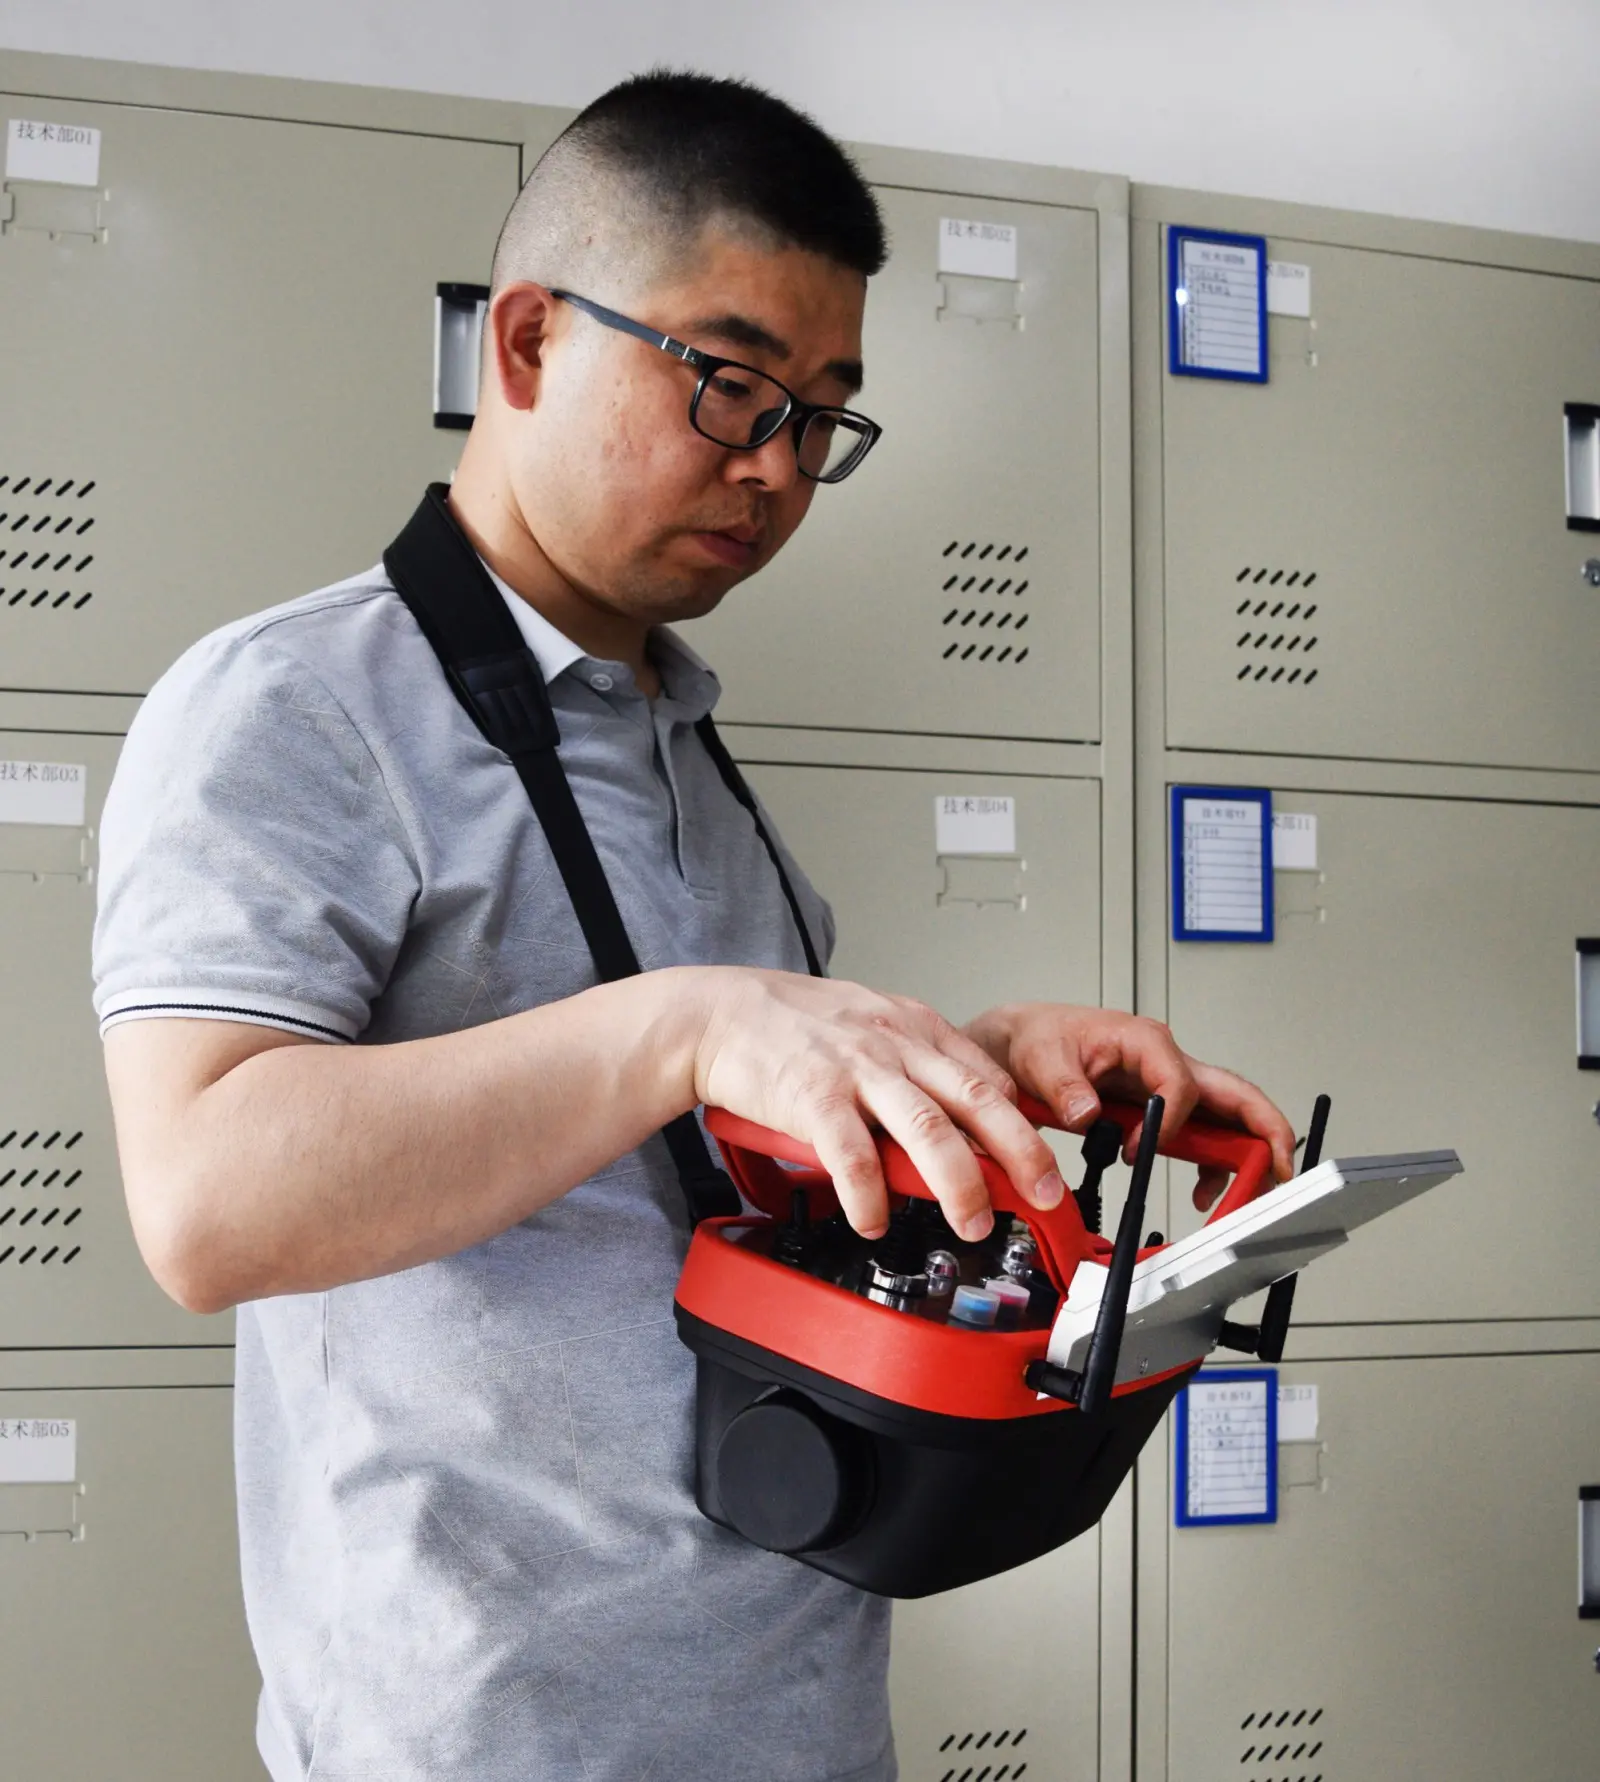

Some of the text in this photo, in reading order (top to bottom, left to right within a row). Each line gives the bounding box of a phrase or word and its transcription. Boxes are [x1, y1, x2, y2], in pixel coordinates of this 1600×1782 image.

[17, 120, 92, 145] 技术部01
[0, 762, 79, 782] 技术部03
[944, 797, 1008, 815] 技术部04
[1277, 1387, 1312, 1403] 部13
